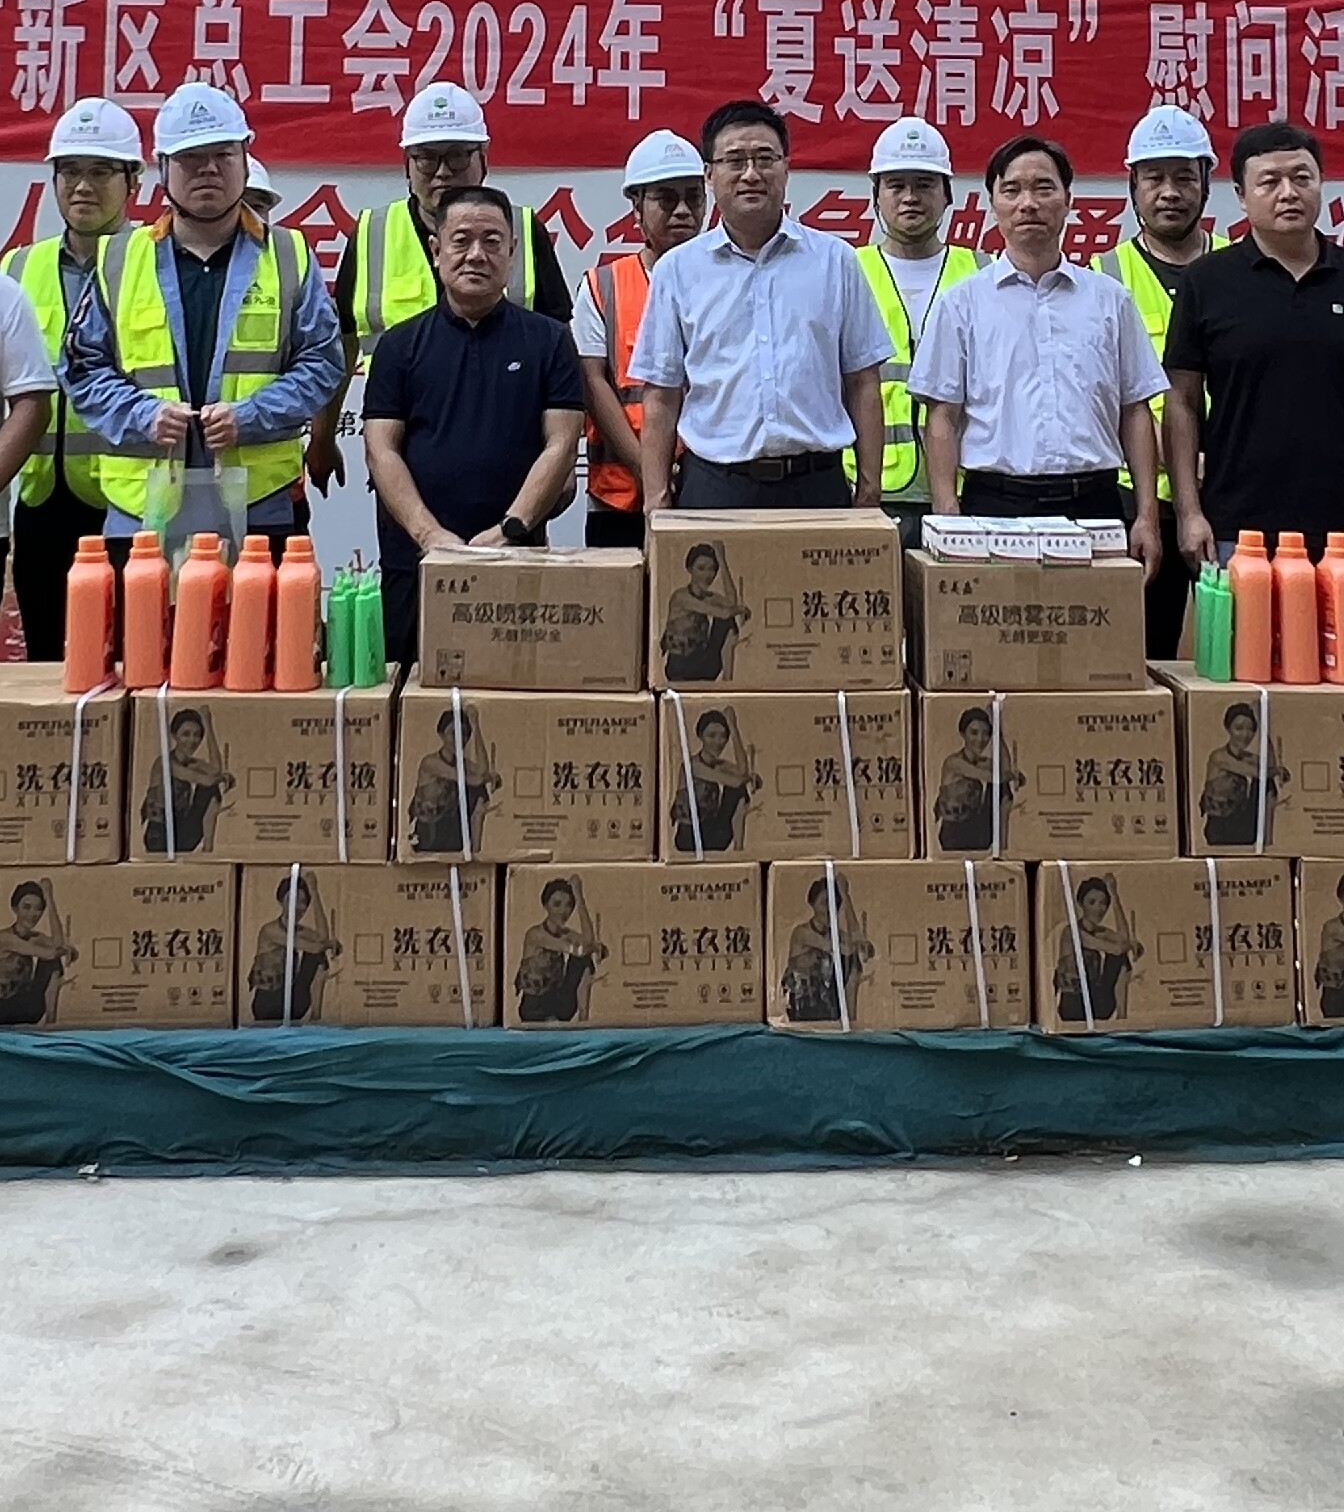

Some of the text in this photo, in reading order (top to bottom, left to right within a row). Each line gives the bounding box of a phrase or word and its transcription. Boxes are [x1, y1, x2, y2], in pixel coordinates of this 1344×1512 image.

[452, 602, 605, 626] 高级喷雾花露水
[802, 589, 891, 618] 洗衣液
[958, 604, 1111, 627] 高级喷雾花露水
[553, 761, 643, 789] 洗衣液
[1075, 758, 1165, 786] 洗衣液
[132, 929, 224, 957] 洗衣液
[661, 926, 752, 955] 洗衣液
